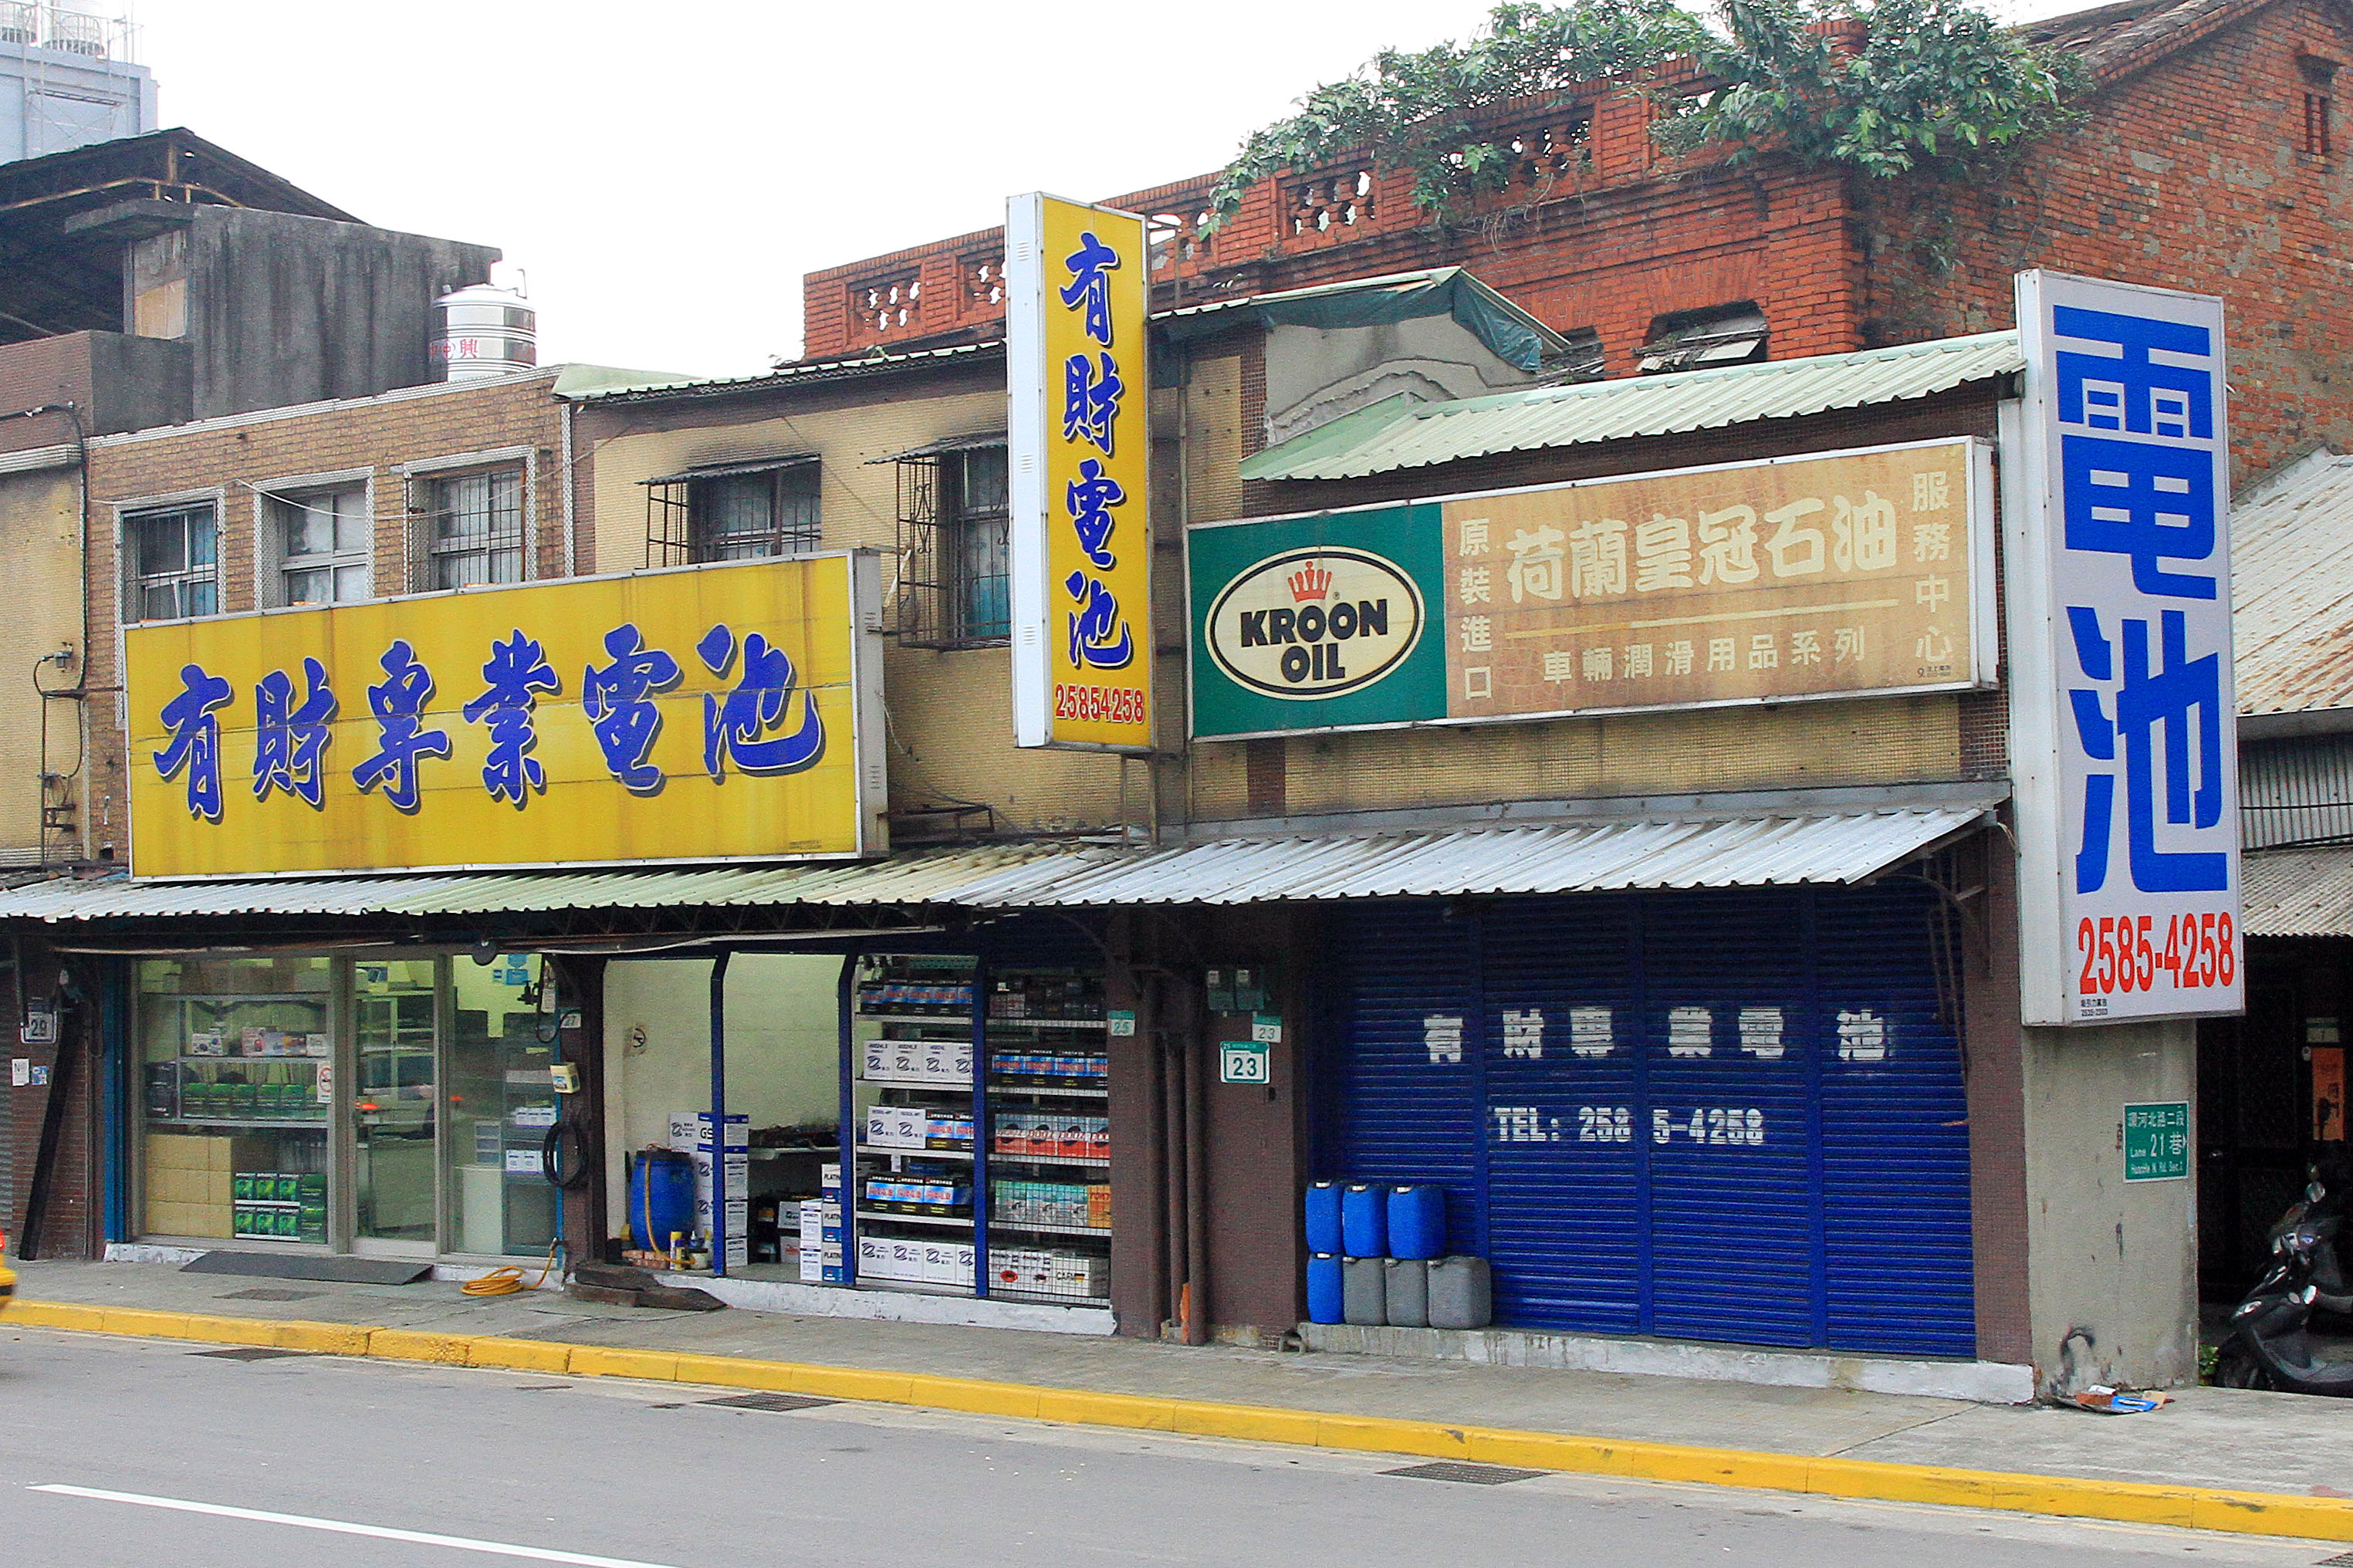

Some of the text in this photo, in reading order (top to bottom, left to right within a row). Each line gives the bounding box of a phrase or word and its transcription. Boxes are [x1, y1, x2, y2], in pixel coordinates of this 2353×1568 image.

[1059, 231, 1133, 669] 有財電池
[1506, 490, 1897, 603] 荷蘭皇冠石油
[1912, 471, 1952, 664] 服務中心
[1239, 598, 1388, 648] KROON
[1458, 518, 1493, 701] 原裝進口
[2054, 305, 2227, 896] 電池
[1280, 643, 1346, 684] OIL
[1543, 628, 1865, 684] 車輛潤滑用品系列
[1055, 683, 1144, 724] 25854258
[2078, 911, 2234, 995] 2585-4258
[1259, 1027, 1275, 1040] 23
[1233, 1057, 1257, 1076] 23
[1494, 1107, 1560, 1142] TEL:
